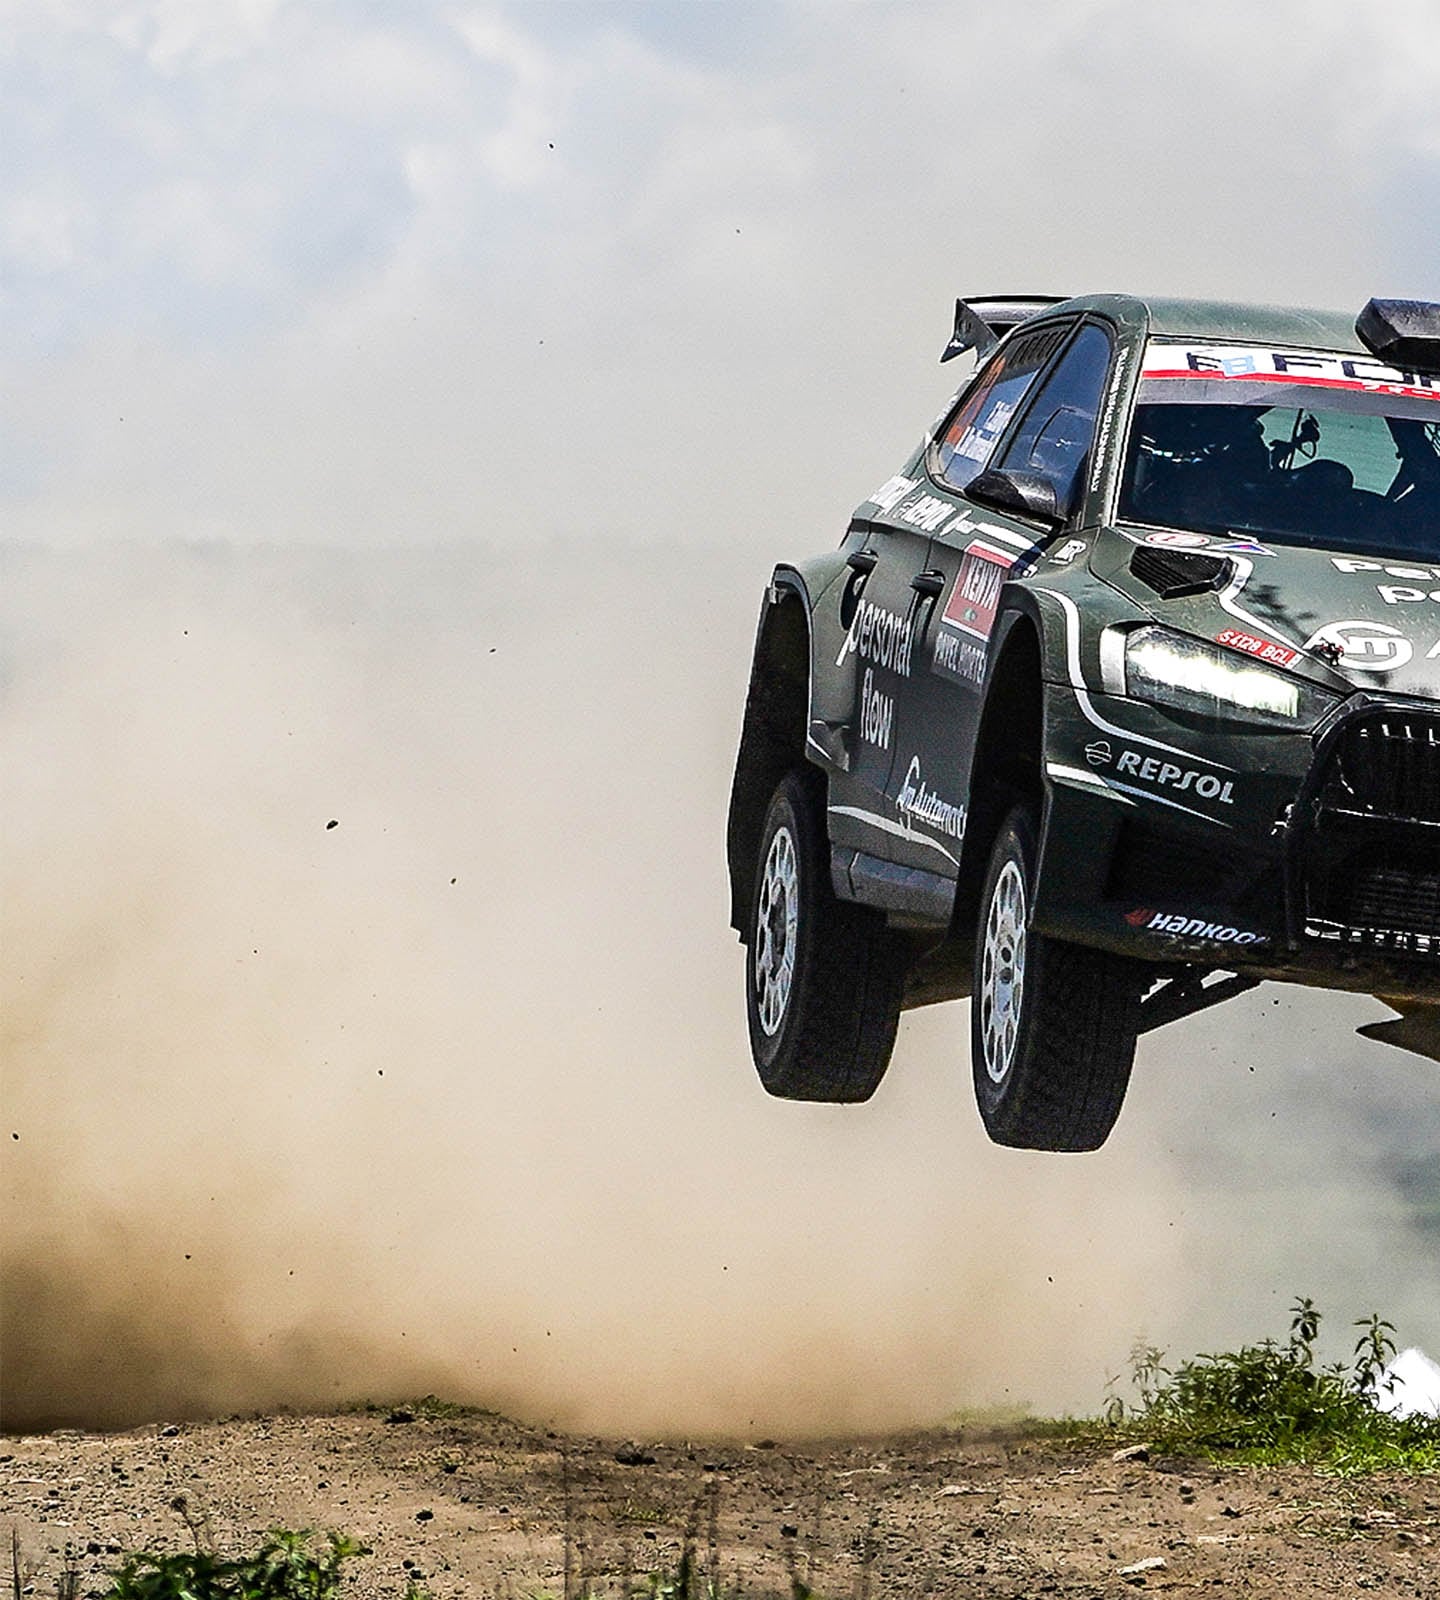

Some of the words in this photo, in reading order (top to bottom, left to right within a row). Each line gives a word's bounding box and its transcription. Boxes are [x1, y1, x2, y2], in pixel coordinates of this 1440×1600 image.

[835, 599, 913, 678] personal
[860, 667, 894, 750] flow
[1116, 750, 1234, 804] REPSOL
